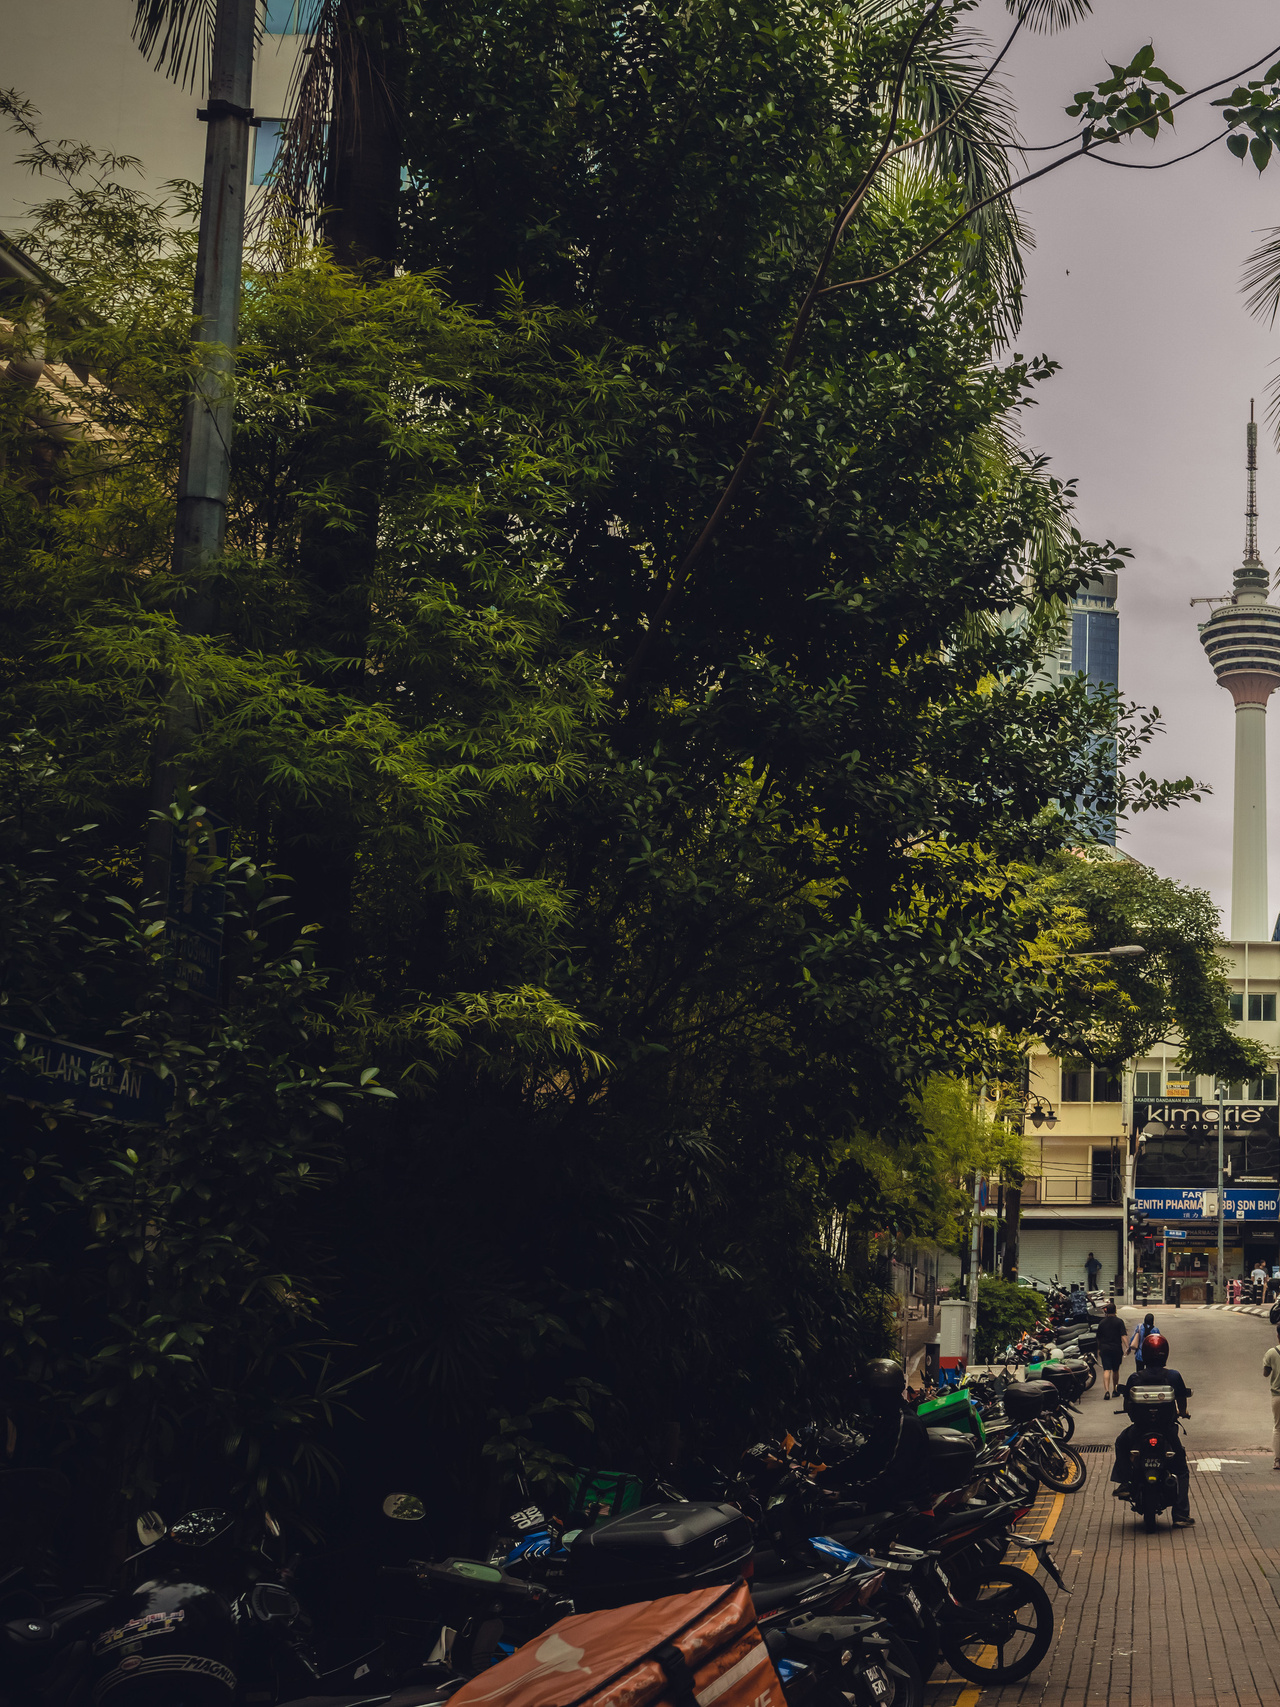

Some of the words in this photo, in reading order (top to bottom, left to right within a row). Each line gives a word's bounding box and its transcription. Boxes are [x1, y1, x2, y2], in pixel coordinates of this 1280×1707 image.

[30, 1046, 82, 1084] JALAN
[1147, 1104, 1262, 1123] kimorie
[1237, 1201, 1256, 1211] SDN
[1257, 1201, 1277, 1211] BHD
[184, 1656, 238, 1690] MAGNUM
